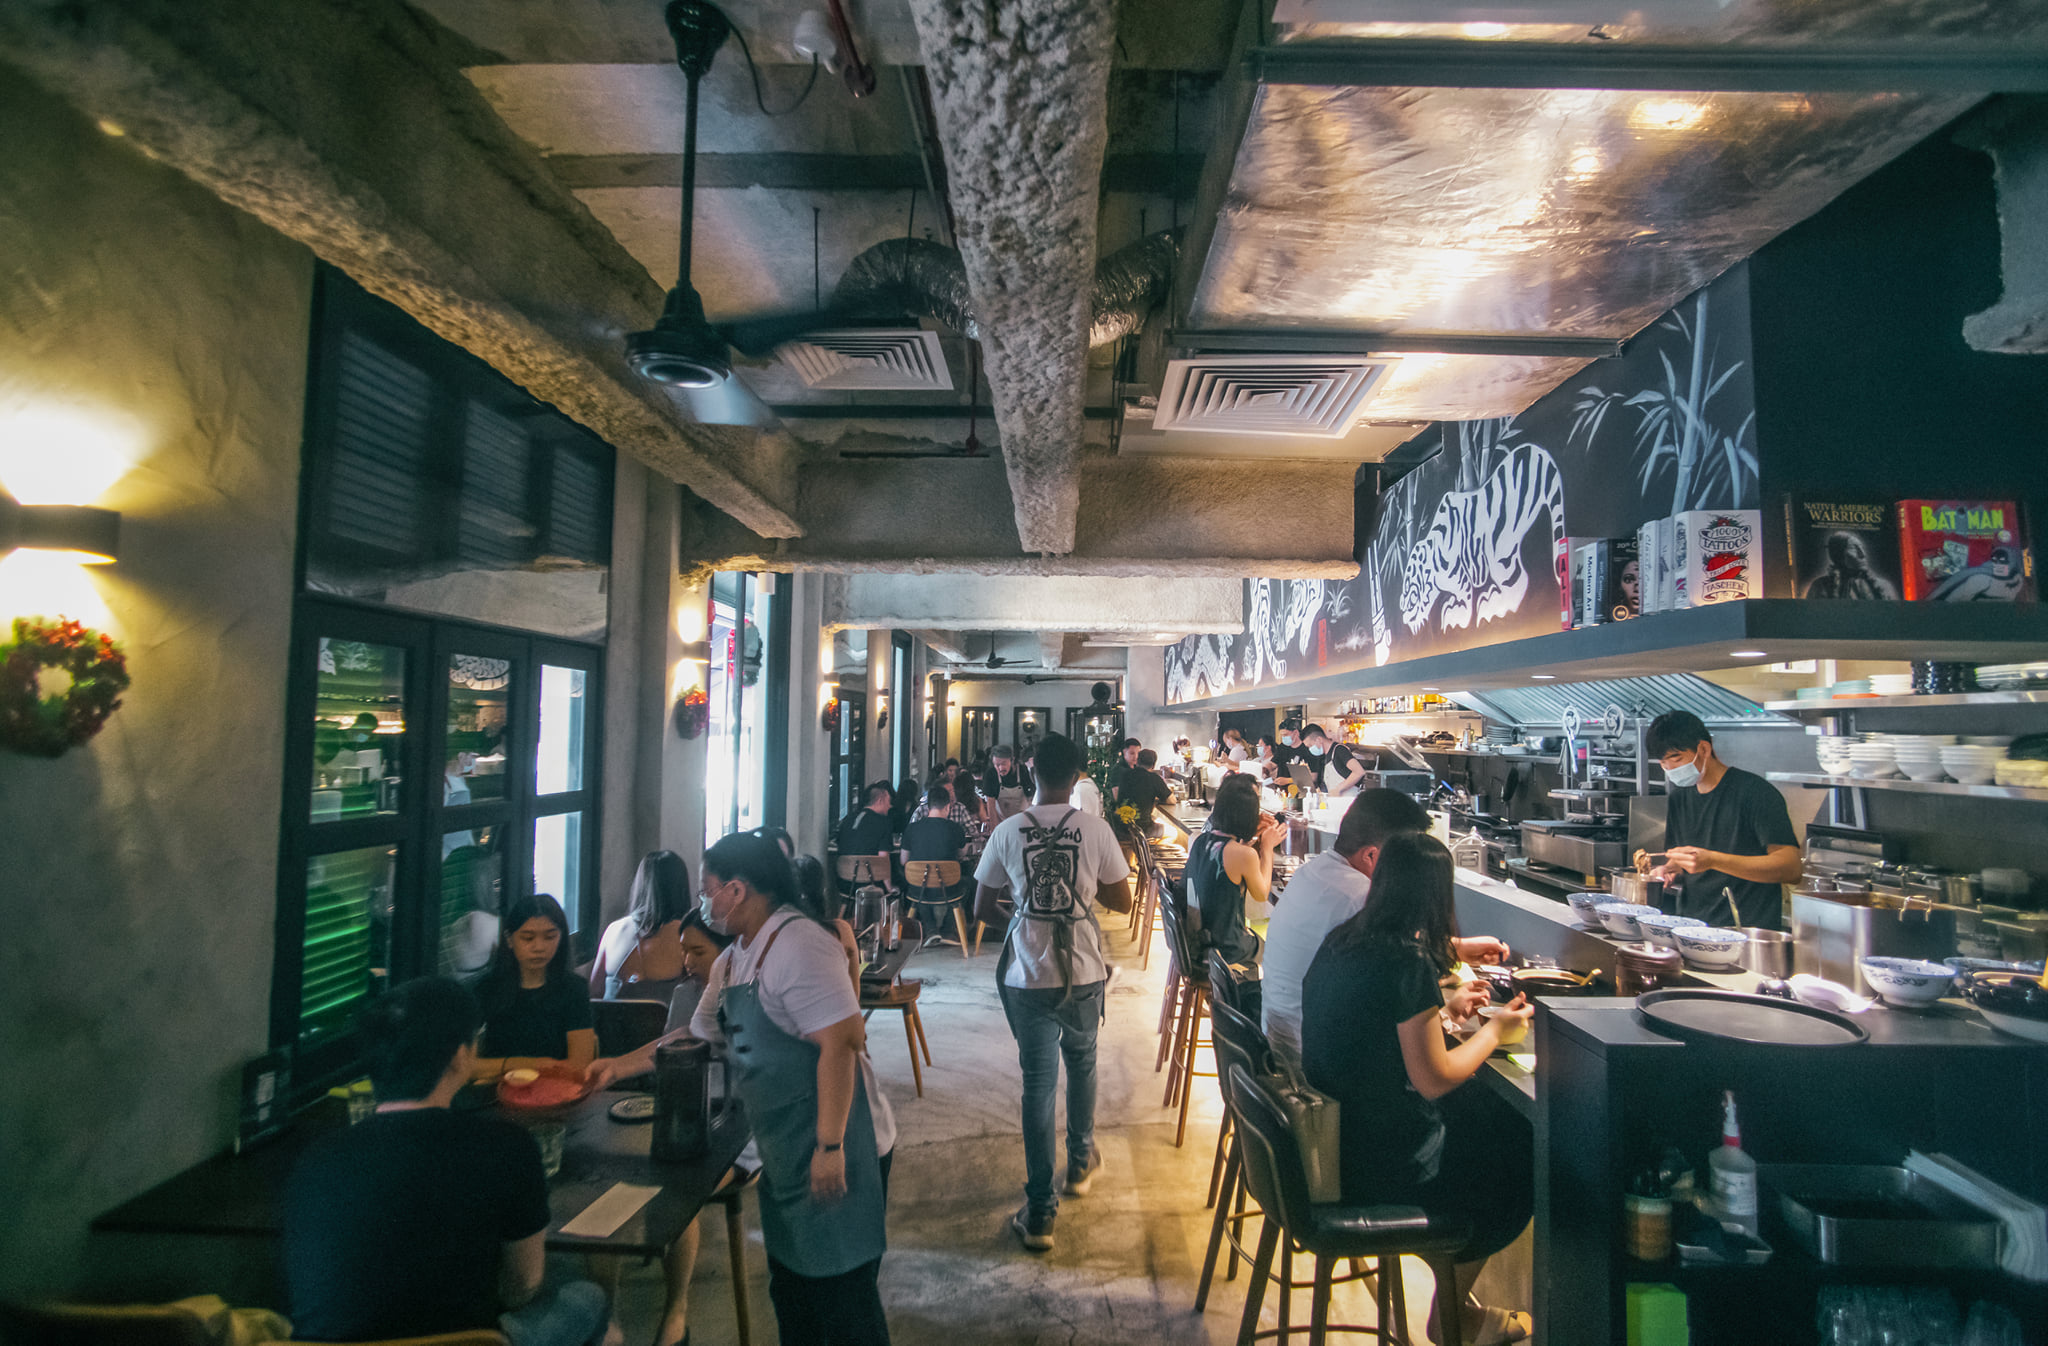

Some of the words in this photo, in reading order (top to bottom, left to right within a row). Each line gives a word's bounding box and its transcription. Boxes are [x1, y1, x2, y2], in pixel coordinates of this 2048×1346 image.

[1803, 502, 1837, 511] NATIVE
[1838, 504, 1886, 513] AMERICAN
[1809, 510, 1882, 523] WARRIORS
[1715, 528, 1738, 537] 1000
[1703, 536, 1749, 551] TATTOOS
[1706, 581, 1745, 593] TASCHEN
